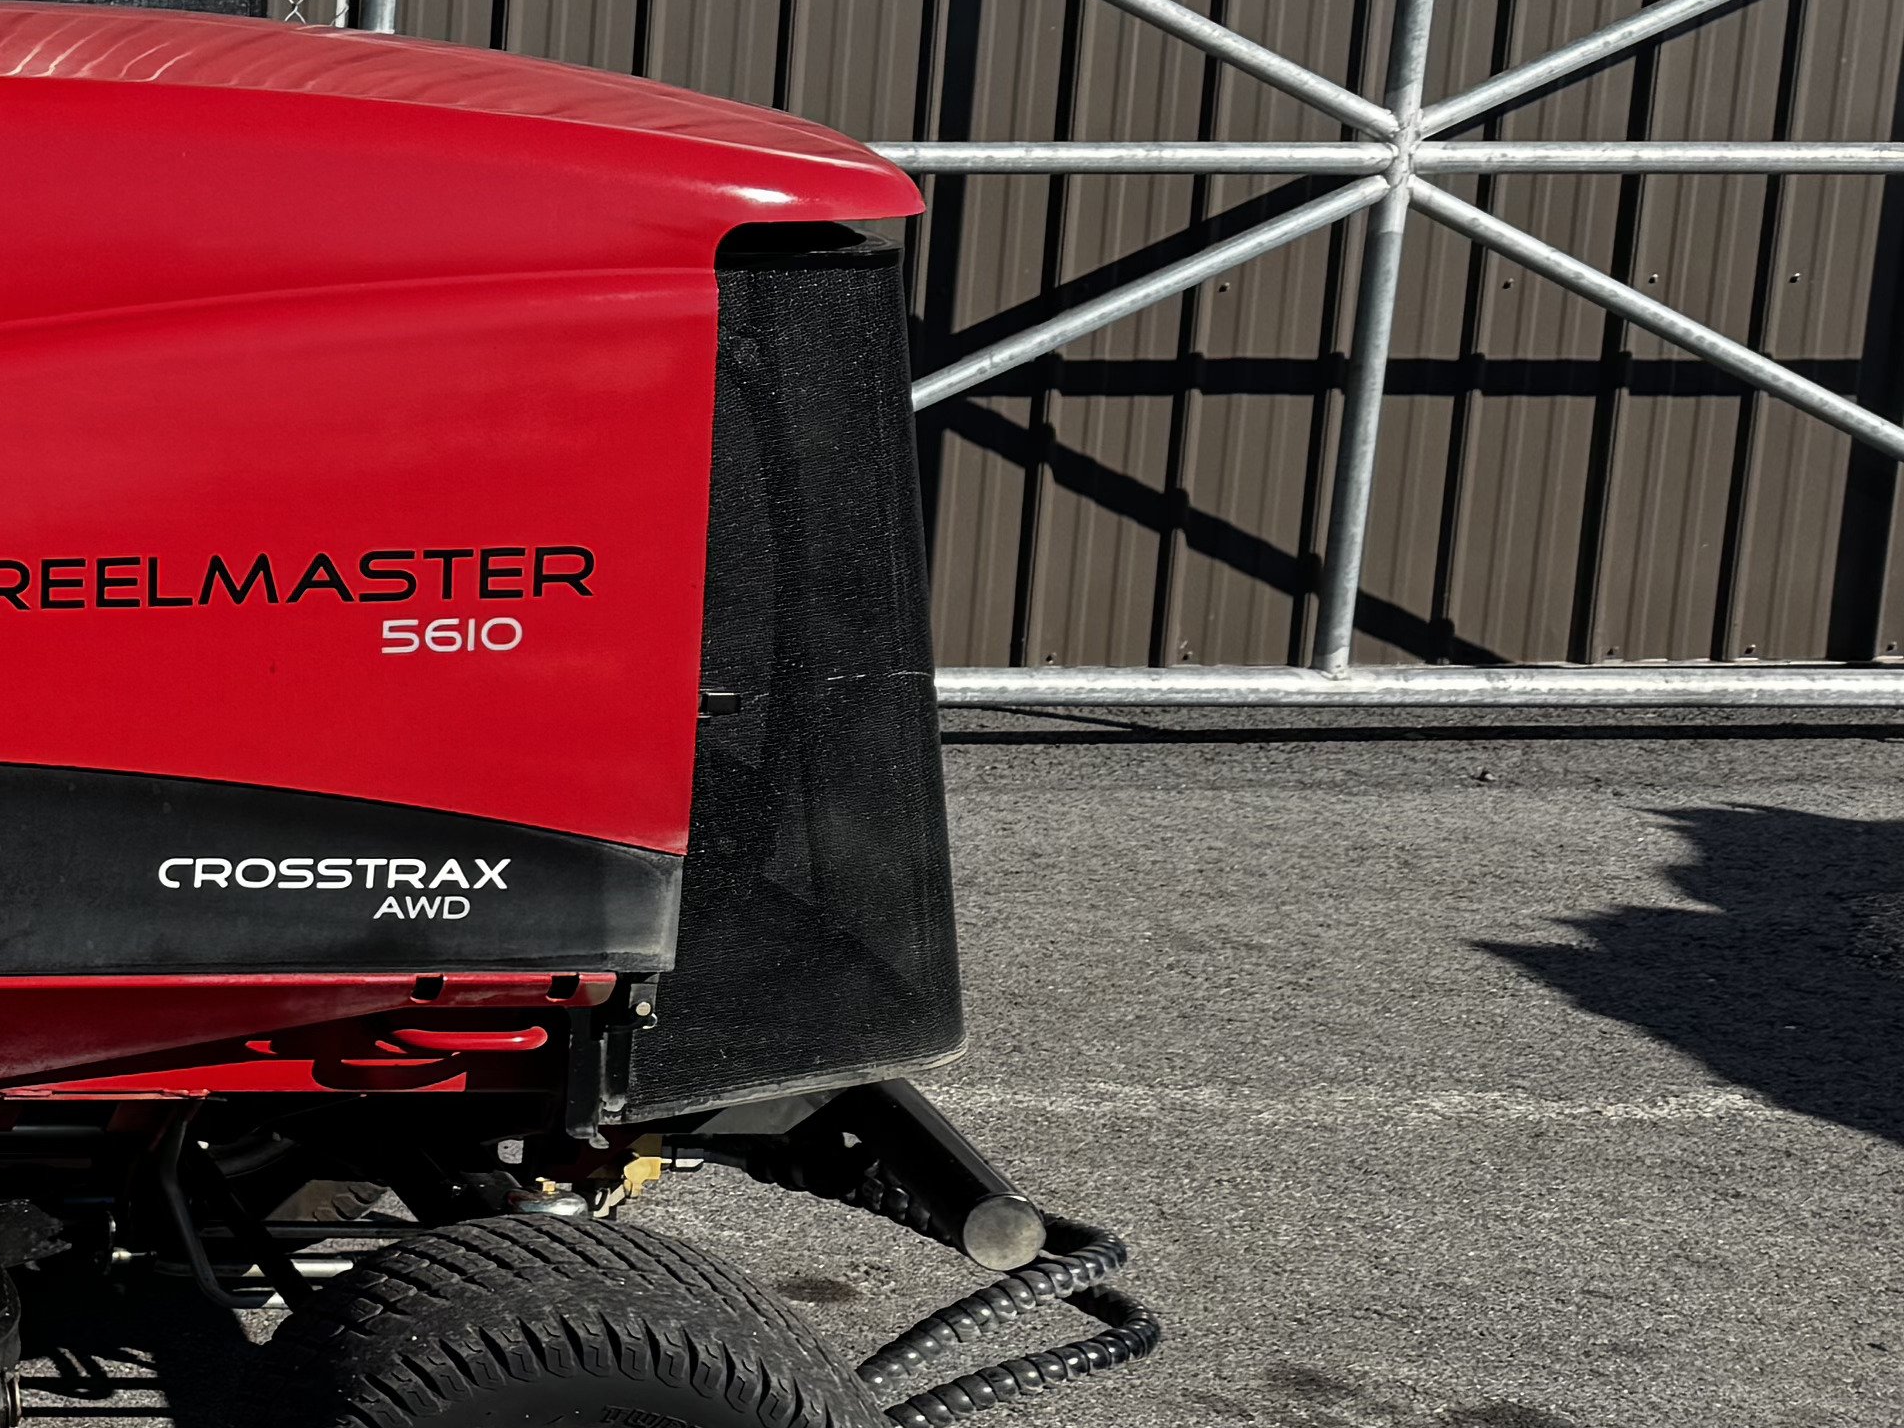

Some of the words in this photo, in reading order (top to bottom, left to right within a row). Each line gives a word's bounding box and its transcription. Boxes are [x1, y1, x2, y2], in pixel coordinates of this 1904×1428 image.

[381, 617, 523, 654] 5610
[158, 858, 512, 889] CROSSTRAX
[373, 895, 471, 920] AWD
